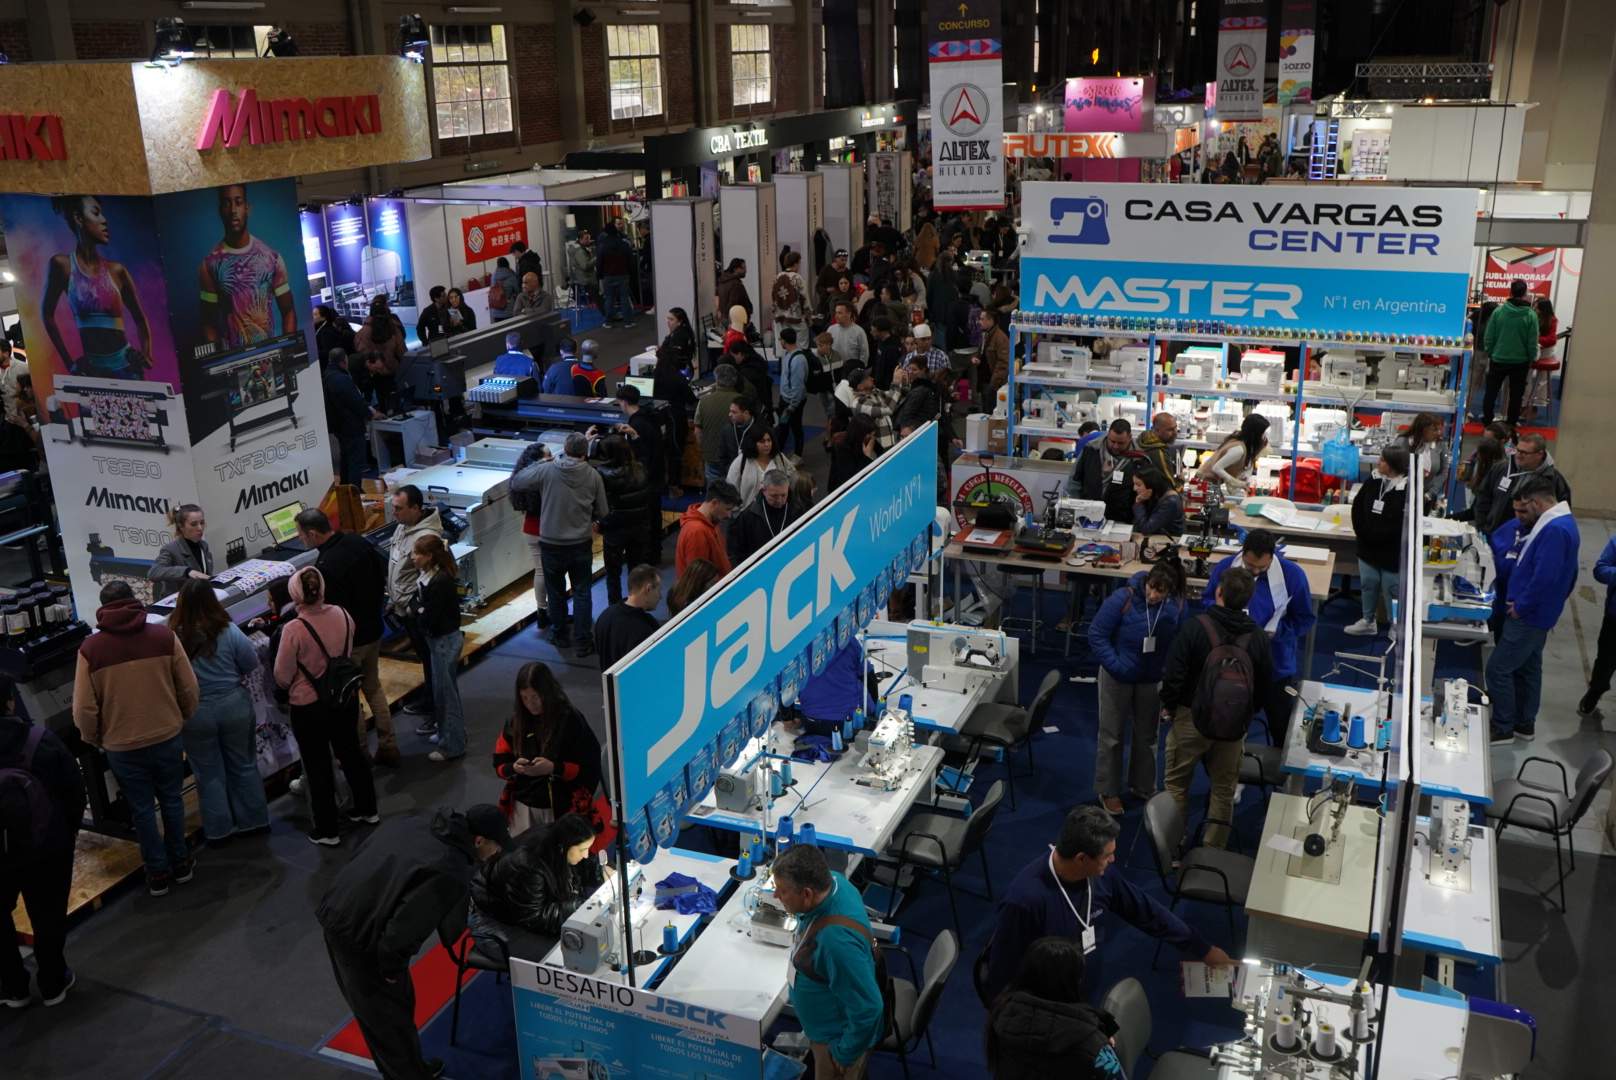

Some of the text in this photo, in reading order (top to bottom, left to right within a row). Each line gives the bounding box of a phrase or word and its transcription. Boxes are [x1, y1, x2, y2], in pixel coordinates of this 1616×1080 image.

[939, 19, 990, 30] CONCURSO
[1220, 79, 1255, 92] ALTEX
[710, 129, 768, 153] CBA TEXTIL
[939, 140, 990, 161] ALTEX
[940, 166, 991, 176] HILADOS
[1124, 199, 1443, 227] CASA VARGAS
[1248, 229, 1440, 256] CENTER
[1485, 272, 1546, 280] SUBLIMADORAS
[1034, 274, 1302, 319] MASTER
[1352, 300, 1371, 310] en
[1374, 298, 1446, 314] Argentina
[92, 456, 162, 479] TS330
[214, 430, 317, 482] TXF300-75
[995, 474, 1028, 498] NEEDLES
[870, 488, 902, 542] World
[114, 525, 173, 547] TS100
[536, 966, 634, 1007] DESAFIO
[530, 1002, 553, 1013] LIBERE
[565, 1011, 603, 1026] POTENCIAL
[538, 1011, 608, 1035] TODOS LOS TEJIDOS
[545, 989, 573, 1000] DESAFIAMOS
[578, 997, 595, 1005] PROBAR
[657, 1017, 688, 1030] INTELIGENCIA
[690, 1026, 714, 1037] ARTIFICIAL
[650, 1033, 675, 1045] LIBERE
[688, 1043, 729, 1059] POTENCIAL
[660, 1043, 734, 1069] TODOS LOS TEJIDOS
